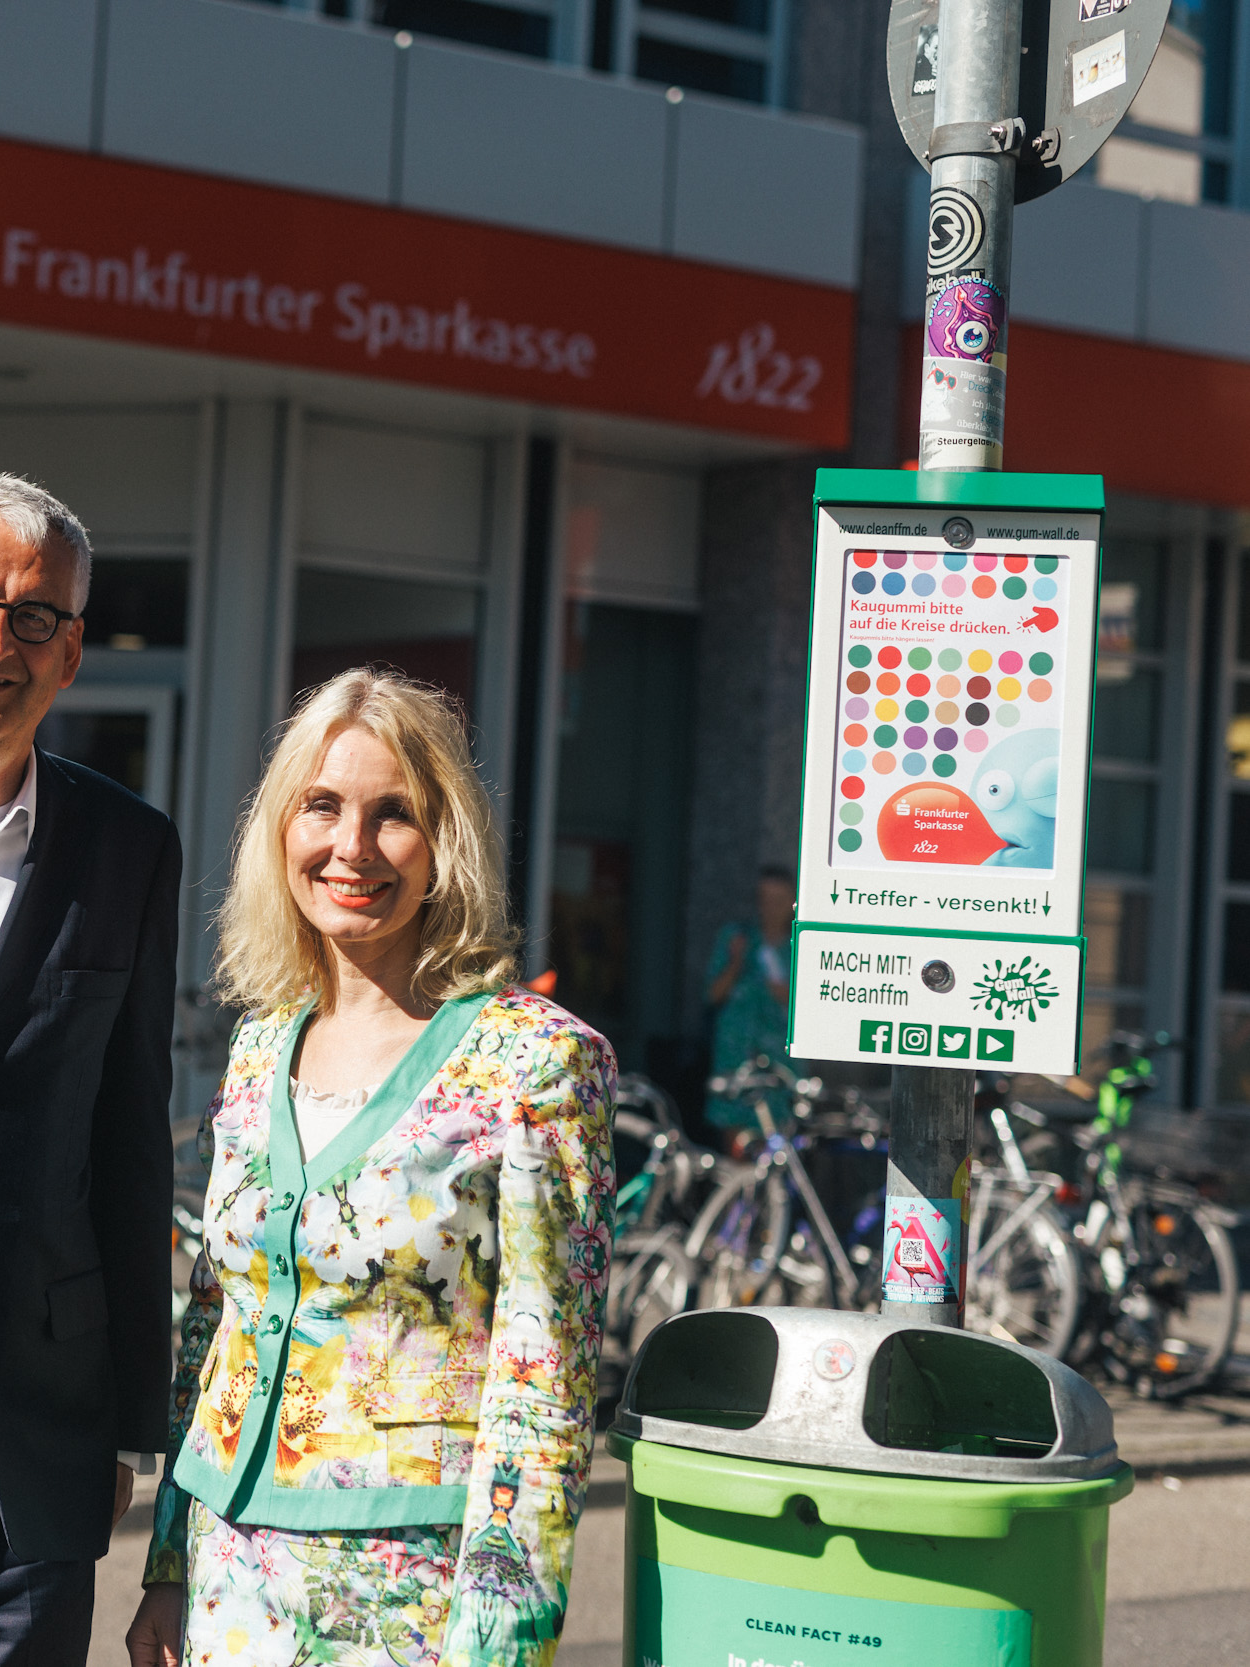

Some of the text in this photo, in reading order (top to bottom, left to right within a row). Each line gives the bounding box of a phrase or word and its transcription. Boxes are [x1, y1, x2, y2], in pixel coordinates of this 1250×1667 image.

[2, 228, 320, 336] Frankfurter
[334, 282, 597, 379] Sparkasse
[697, 322, 822, 413] 1822
[839, 522, 928, 536] www.cleanffm.de
[987, 526, 1080, 541] www.gum-wall.de
[850, 599, 964, 616] Kaugummi bitte
[849, 617, 1011, 634] auf die Kreise drücken.
[914, 807, 970, 819] Frankfurter
[914, 819, 964, 831] Sparkasse
[912, 839, 939, 854] 1822
[844, 887, 918, 908] Treffer
[936, 896, 1037, 915] versenkt!
[820, 950, 912, 976] MACH MIT!
[819, 979, 909, 1007] #cleanffm
[994, 977, 1025, 992] Gum
[1005, 985, 1036, 1002] Wall
[928, 1287, 945, 1296] BEATS
[745, 1617, 883, 1648] CLEAN FACT #49
